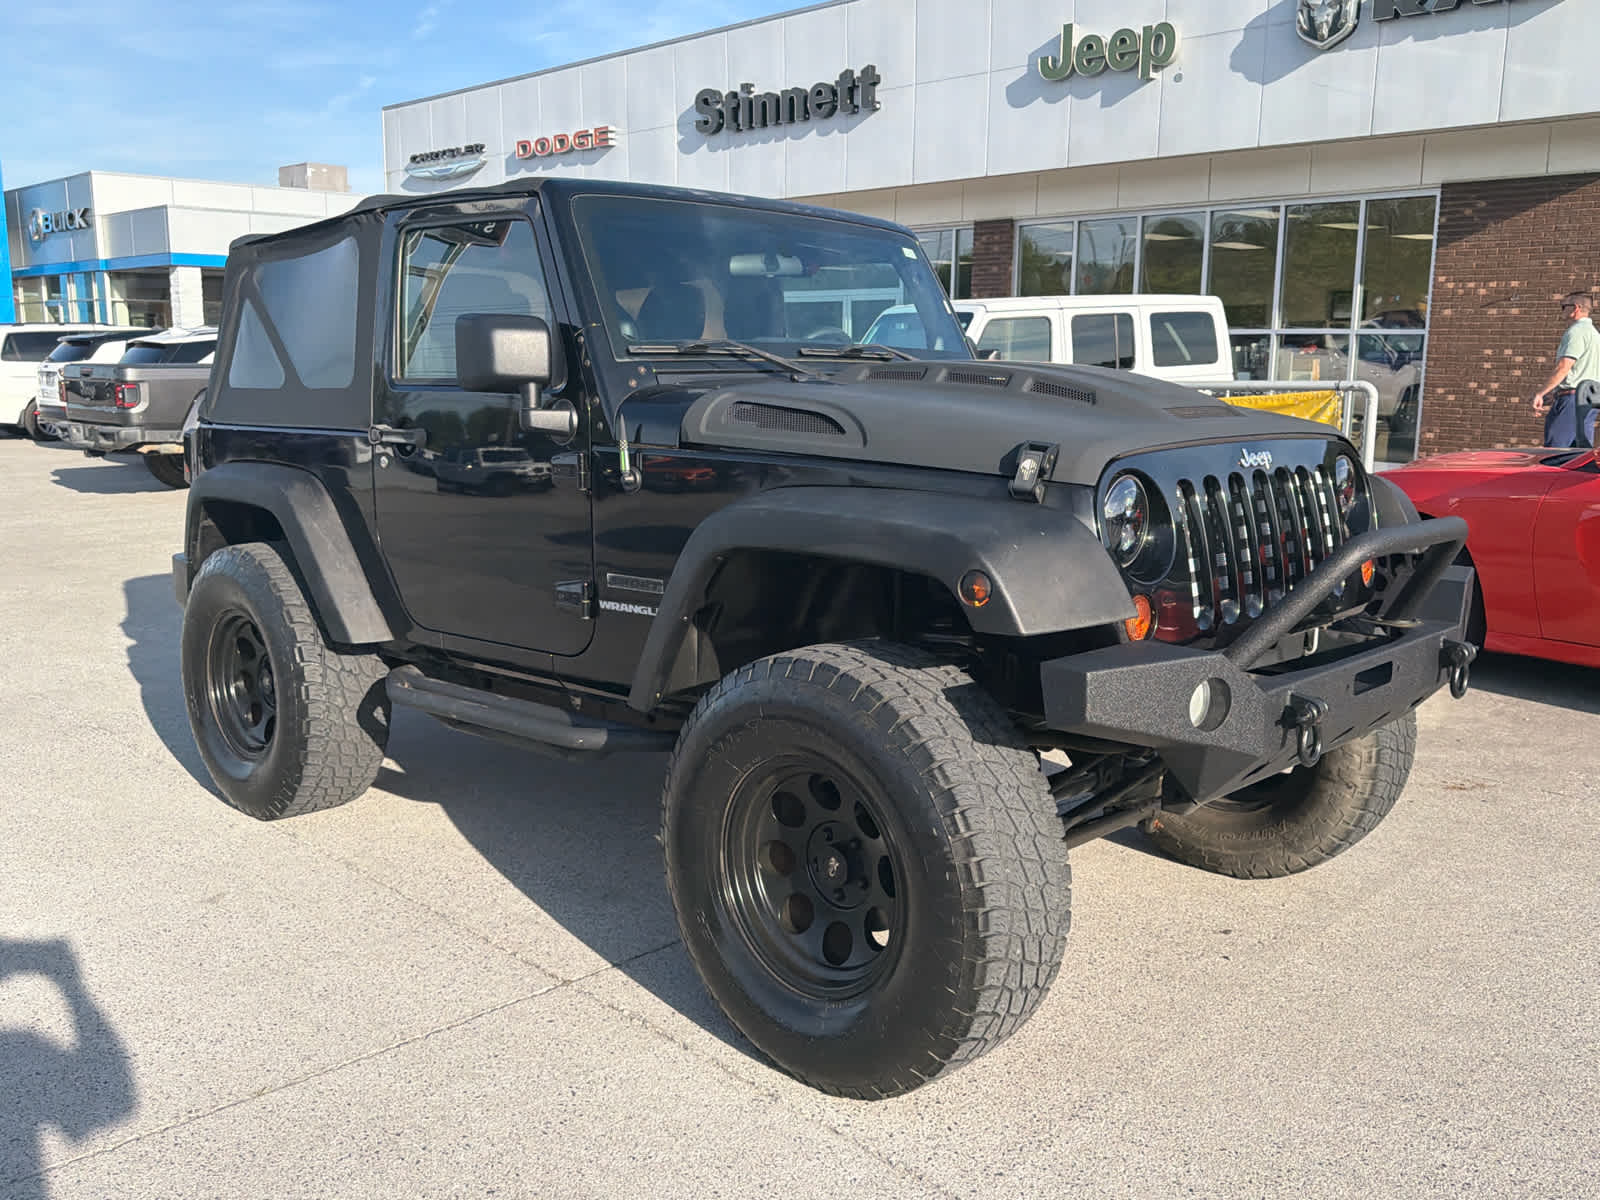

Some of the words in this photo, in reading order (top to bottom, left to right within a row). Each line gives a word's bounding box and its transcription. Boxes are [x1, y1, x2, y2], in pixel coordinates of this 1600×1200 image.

[1038, 22, 1177, 81] Jeep
[695, 64, 880, 135] Stinnett
[516, 126, 614, 160] DODGE
[42, 208, 90, 233] BUICK
[1240, 447, 1272, 470] Jeep
[599, 600, 658, 616] WRANGL
